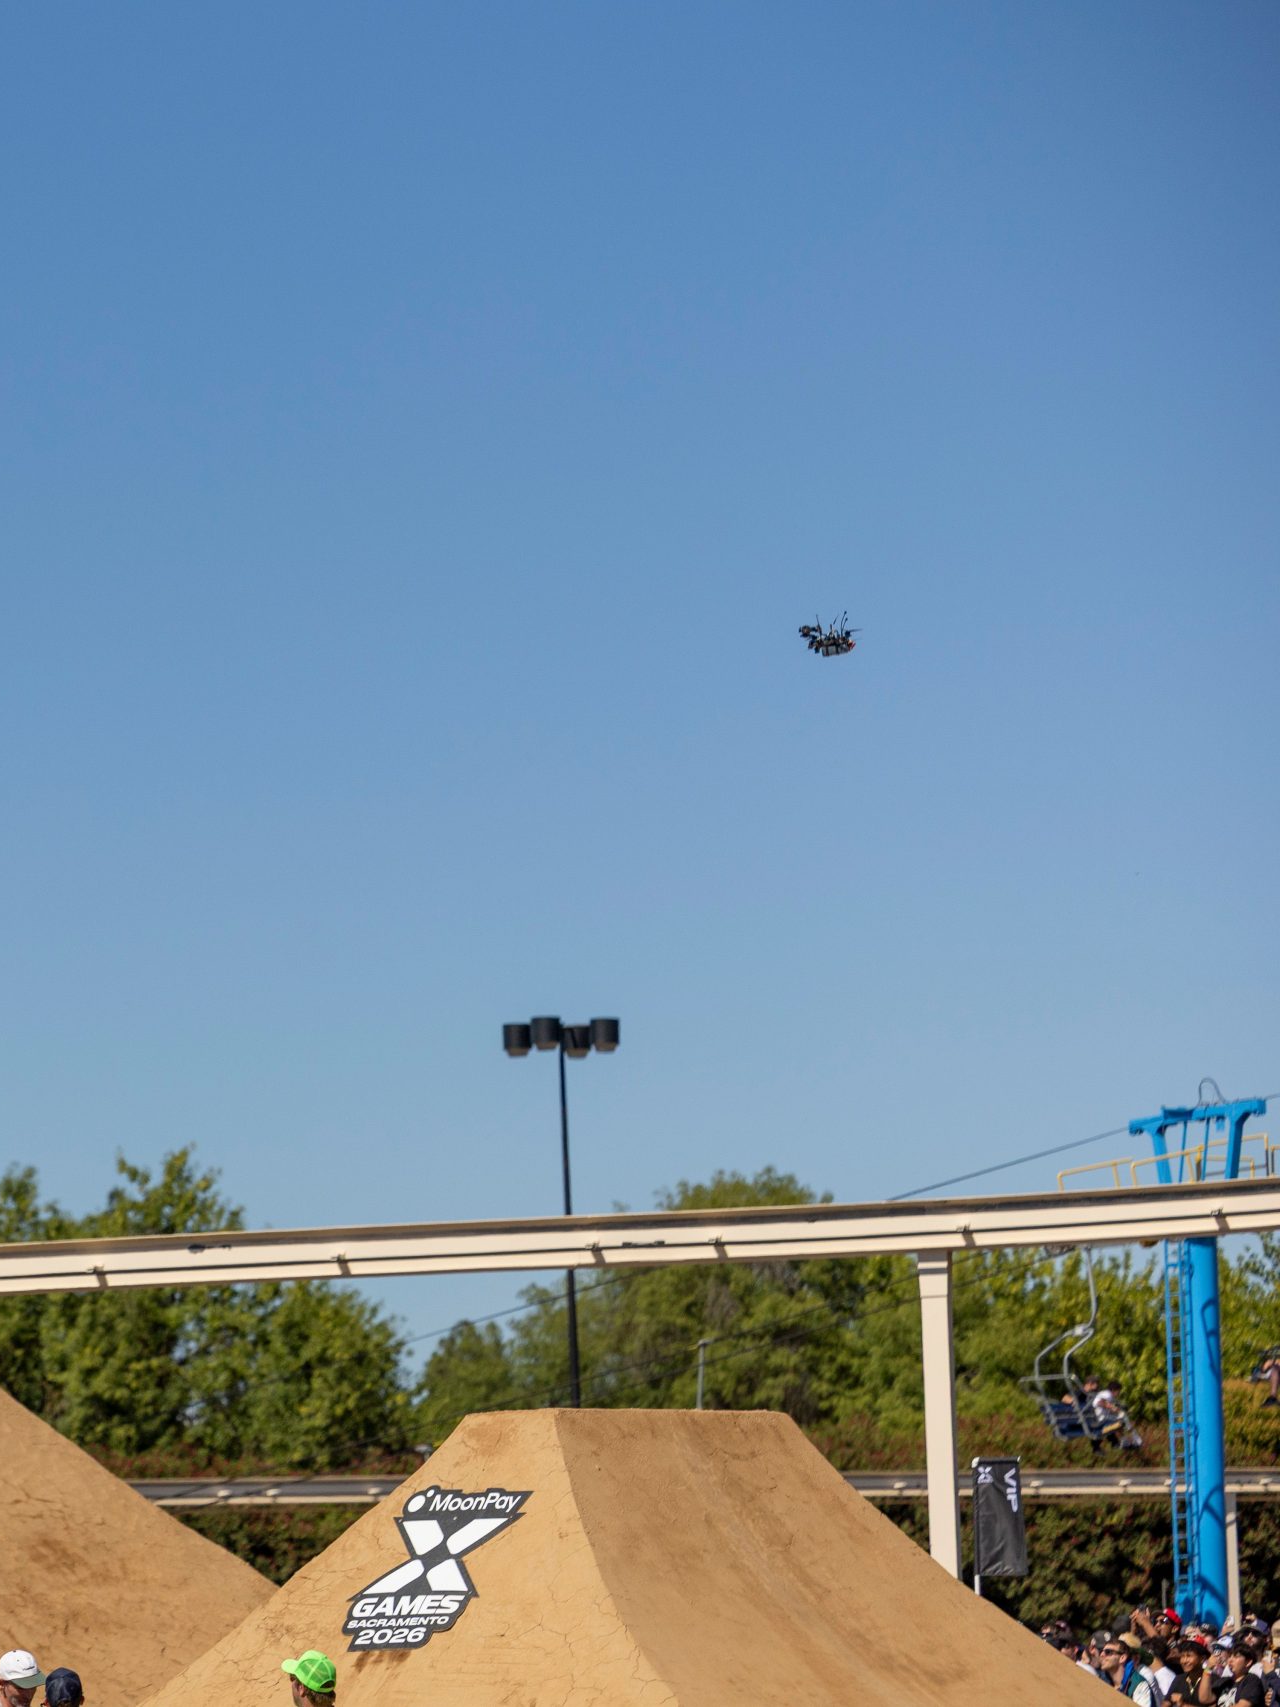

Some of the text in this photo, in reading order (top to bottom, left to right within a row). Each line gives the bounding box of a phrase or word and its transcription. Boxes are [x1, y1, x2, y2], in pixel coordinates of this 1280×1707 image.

[1004, 1467, 1018, 1513] VIP
[428, 1492, 522, 1513] MoonPay
[352, 1594, 466, 1618] GAMES
[347, 1616, 450, 1630] SACRAMENTO
[354, 1627, 427, 1645] 2026
